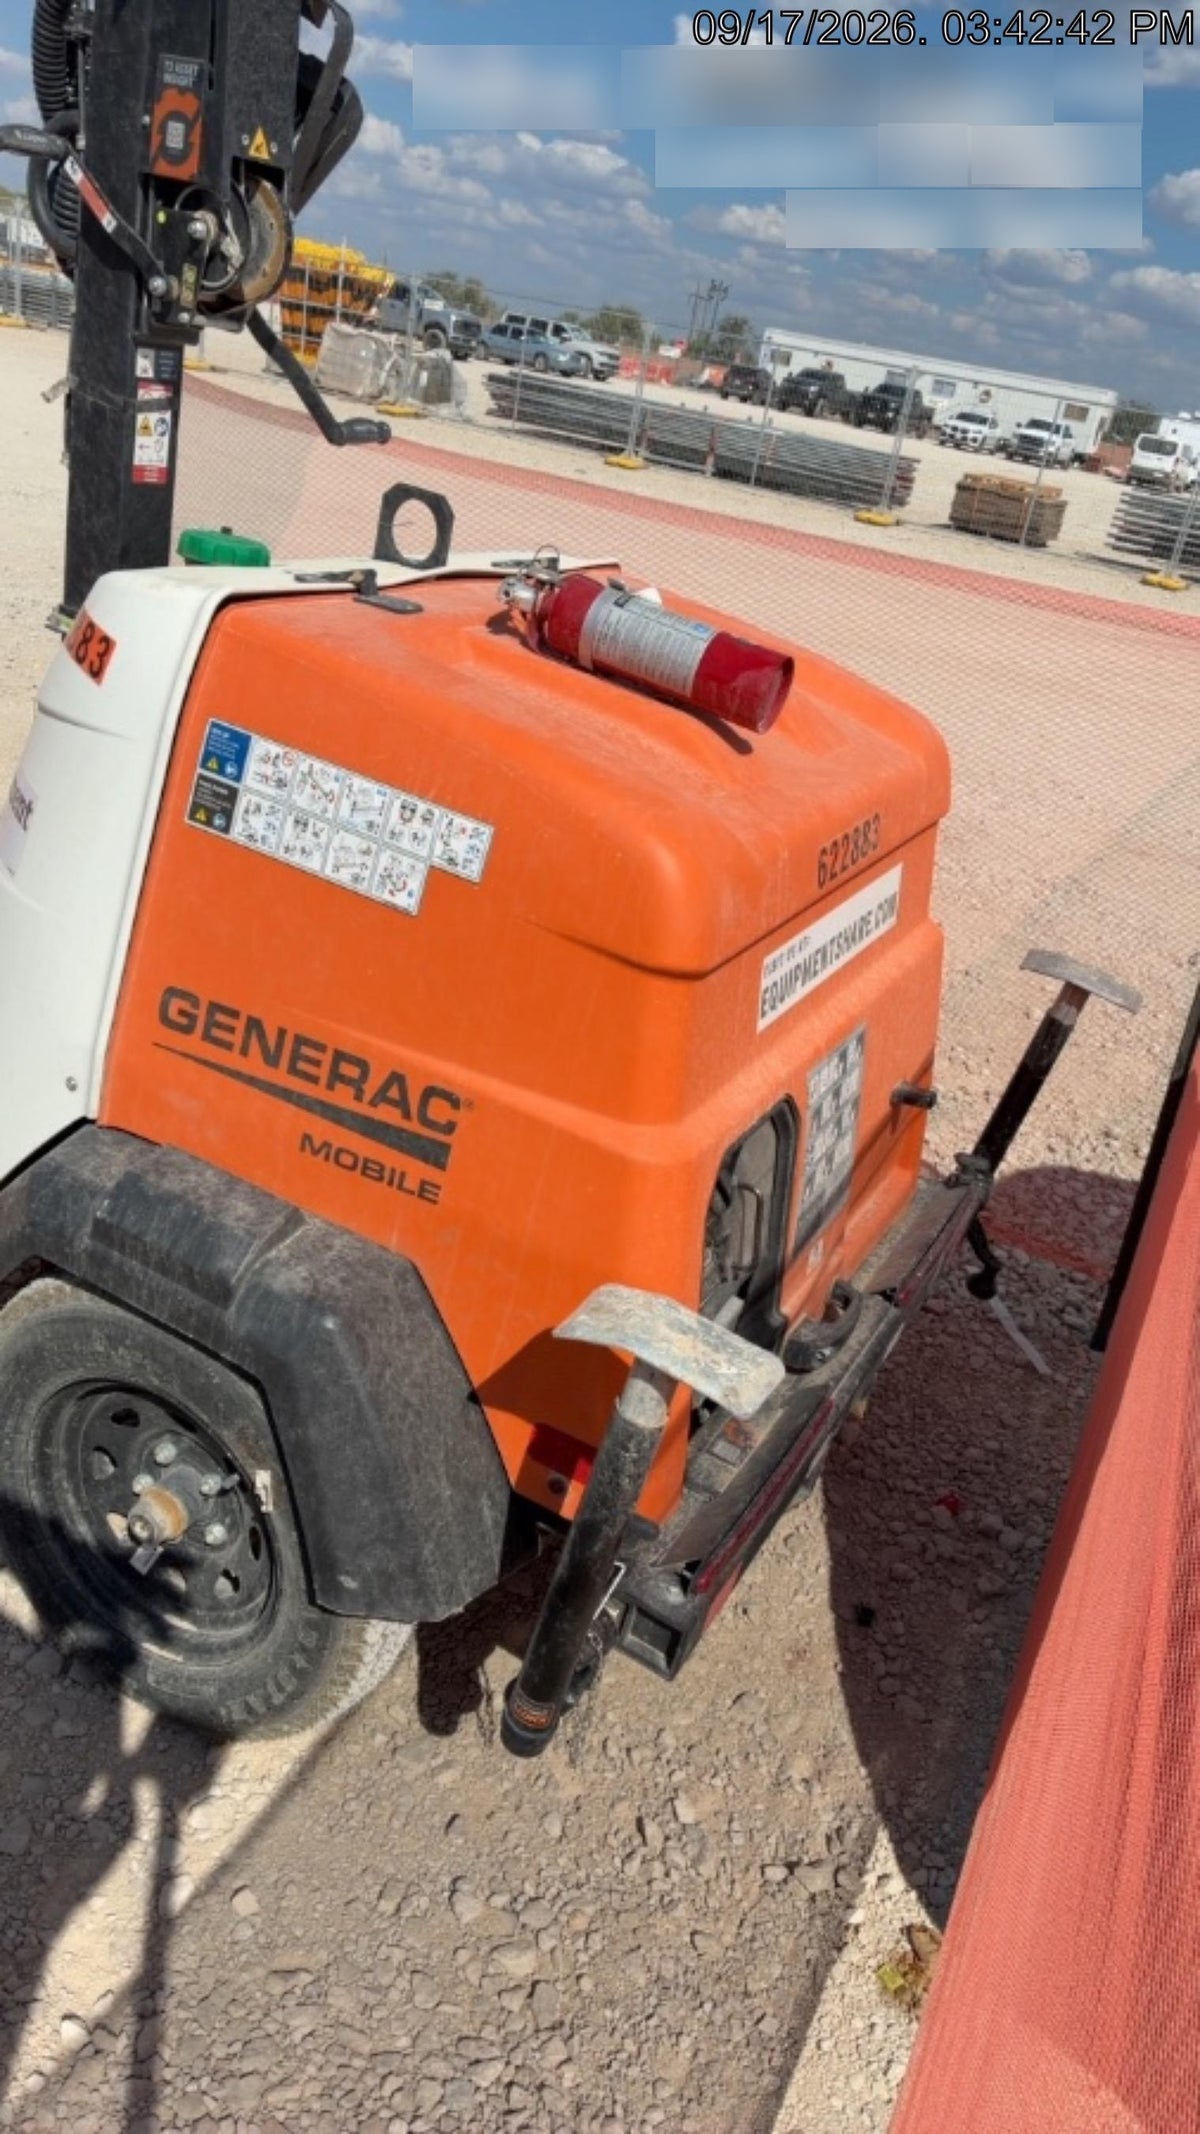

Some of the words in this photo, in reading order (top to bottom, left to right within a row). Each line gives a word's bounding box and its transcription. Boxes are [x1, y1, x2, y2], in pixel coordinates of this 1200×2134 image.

[66, 620, 112, 680] 83
[817, 812, 881, 889] 622883
[760, 891, 897, 1019] EQUIPMENTSHARE.COM
[158, 985, 462, 1137] GENERAC
[298, 1132, 443, 1206] MOBILE
